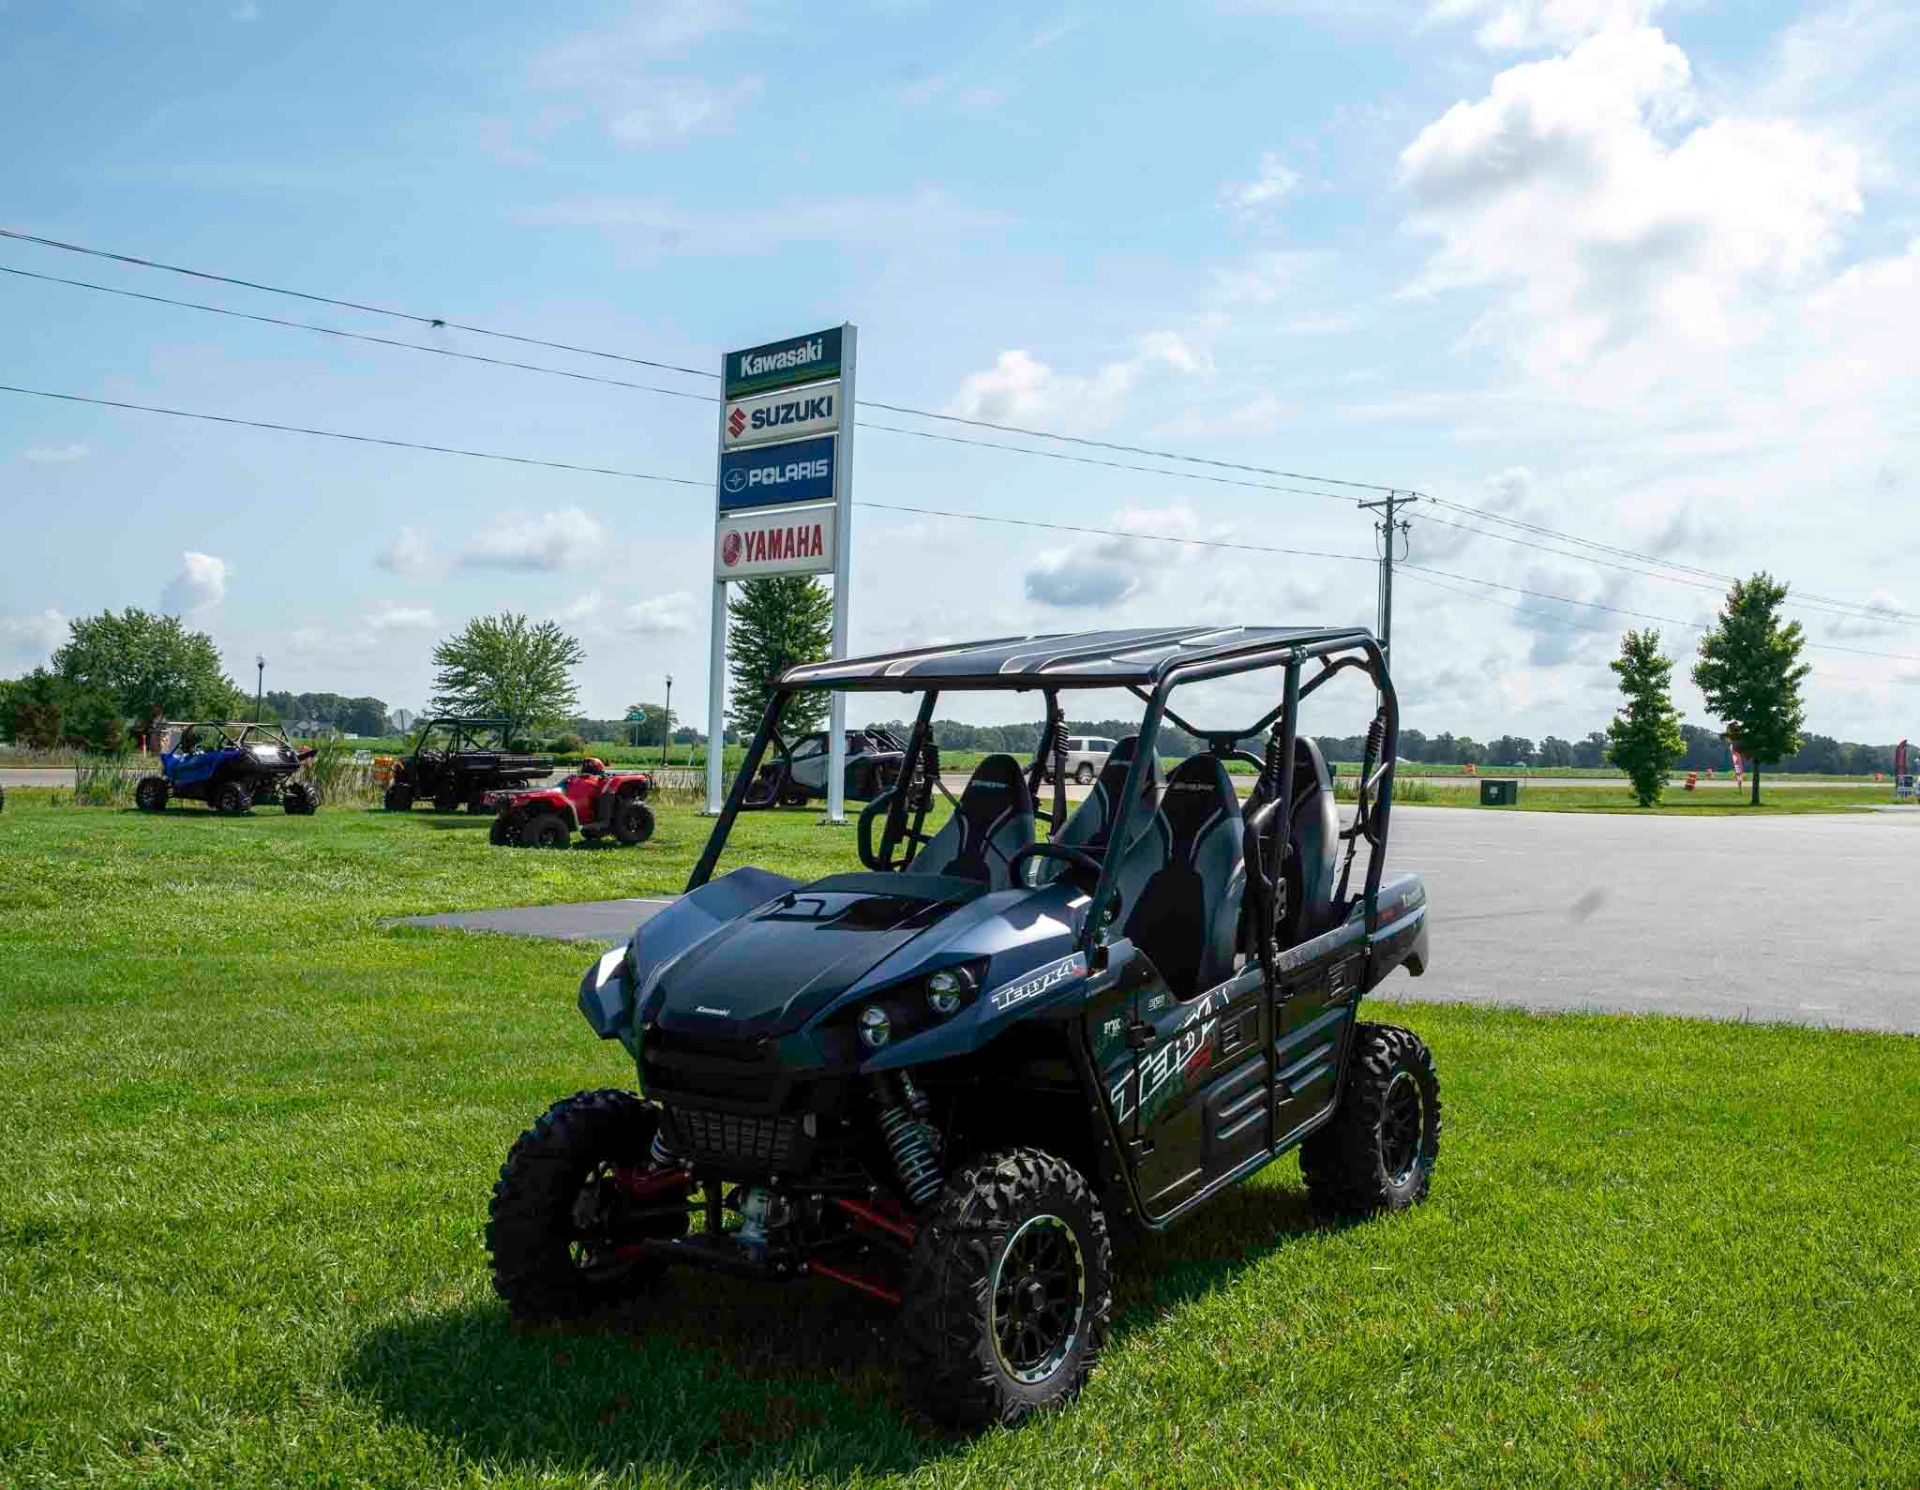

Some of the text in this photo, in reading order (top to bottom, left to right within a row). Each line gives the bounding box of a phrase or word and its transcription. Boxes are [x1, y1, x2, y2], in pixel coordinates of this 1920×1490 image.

[740, 338, 823, 378] Kawasaki
[751, 396, 833, 430] SUZUKI
[749, 459, 828, 487] POLARIS
[744, 524, 823, 562] YAMAHA
